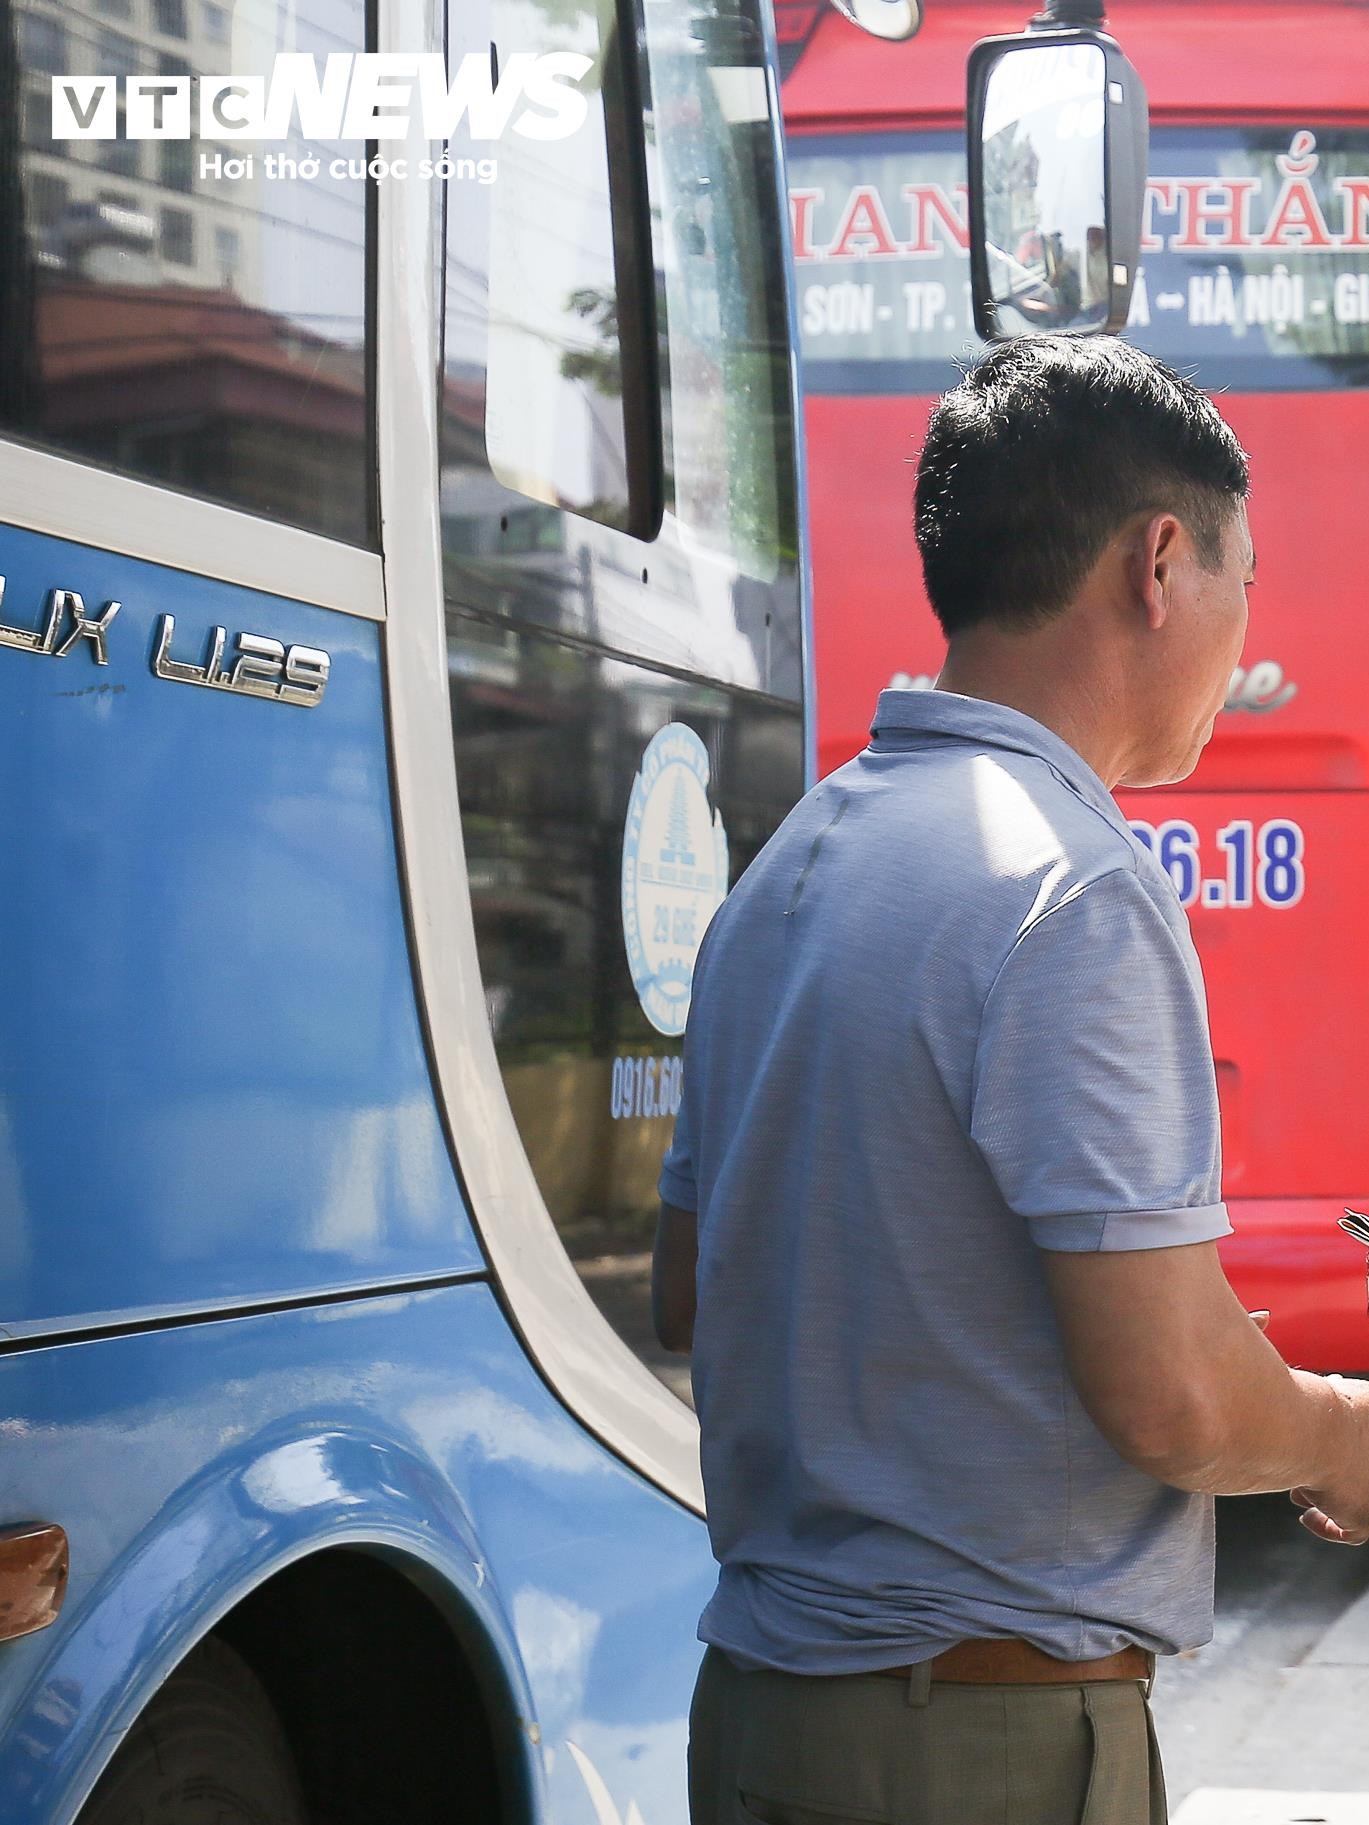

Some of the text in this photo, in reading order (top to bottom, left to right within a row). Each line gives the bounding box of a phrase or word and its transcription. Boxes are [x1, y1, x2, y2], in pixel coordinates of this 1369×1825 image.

[903, 281, 955, 334] TP.
[1188, 265, 1235, 326] HÀ
[1243, 264, 1304, 334] NỘI
[1128, 818, 1305, 910] 6.18
[611, 1055, 683, 1119] 0916.60
